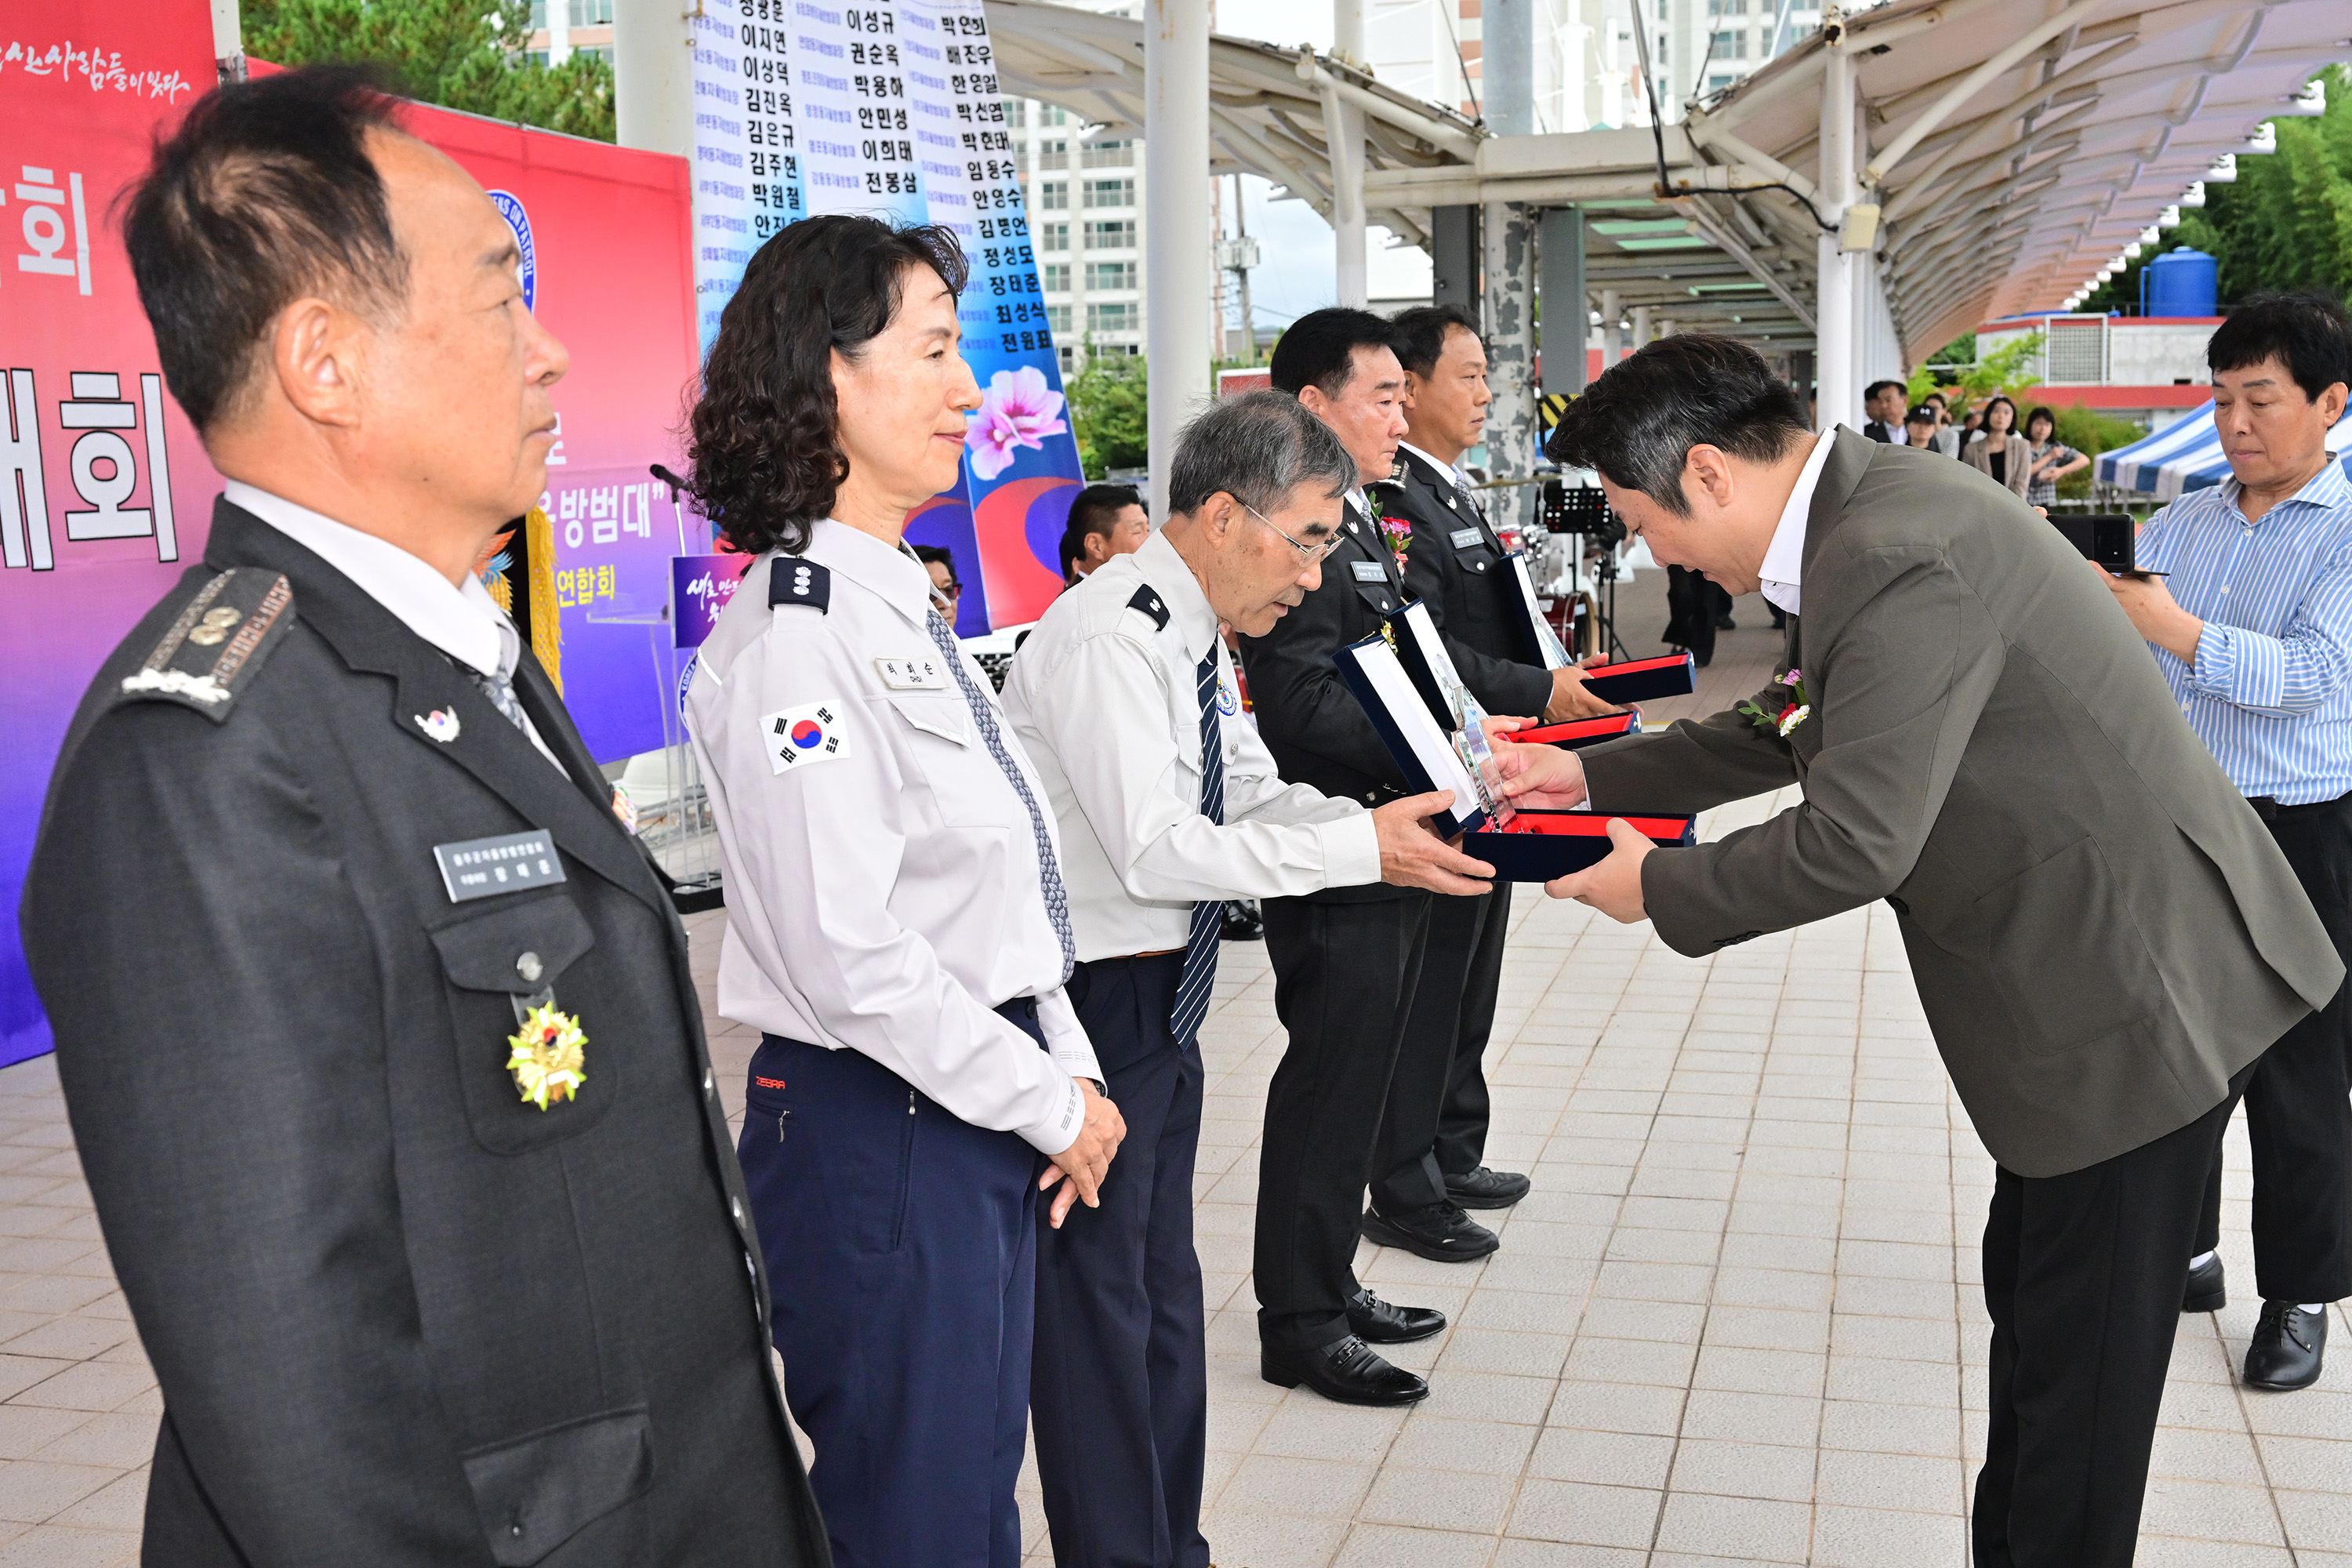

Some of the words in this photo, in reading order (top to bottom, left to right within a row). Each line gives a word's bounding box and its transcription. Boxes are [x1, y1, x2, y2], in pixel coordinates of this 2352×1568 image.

[848, 10, 893, 33] 이성규
[742, 24, 786, 54] 이지연
[851, 43, 898, 66] 권순옥
[744, 56, 788, 85] 이상덕
[855, 76, 902, 97] 박용하
[746, 89, 791, 116] 김진옥
[858, 108, 907, 130] 안민성
[749, 121, 793, 147] 김은규
[863, 140, 912, 161] 이희태
[751, 152, 797, 179] 김주현
[968, 160, 1014, 180] 임용수
[753, 184, 799, 209] 박원철
[973, 189, 1020, 209] 안영수
[0, 165, 92, 296] 회
[510, 203, 523, 227] ON
[517, 220, 535, 280] PATROL
[984, 245, 1033, 267] 정성모
[557, 564, 615, 608] 연합회
[718, 578, 739, 596] 만드
